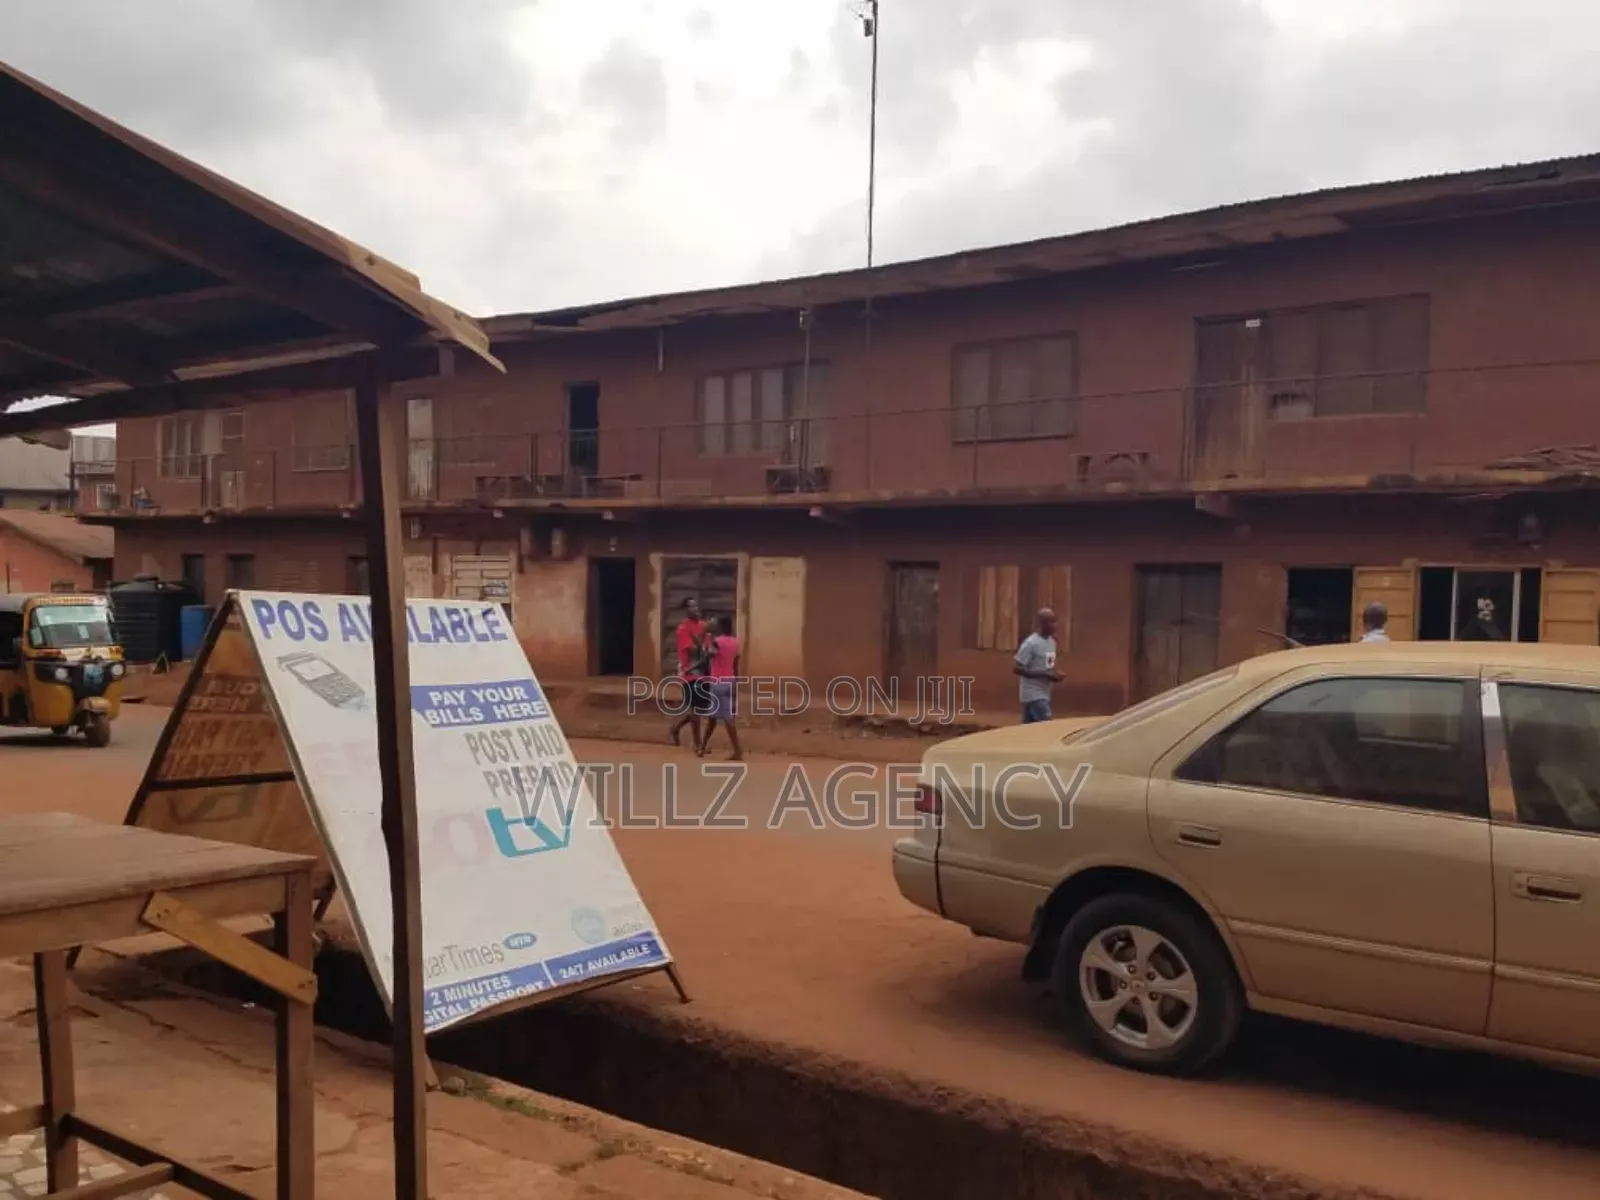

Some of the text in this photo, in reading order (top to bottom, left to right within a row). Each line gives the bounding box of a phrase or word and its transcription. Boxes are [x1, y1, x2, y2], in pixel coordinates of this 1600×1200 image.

[251, 599, 329, 642] POS
[429, 686, 529, 706] PAY YOUR
[424, 701, 547, 725] BILLS HERE
[464, 724, 565, 766] POST PAID
[587, 943, 651, 972] AVAILABLE
[430, 975, 512, 1006] 2 MINUTES
